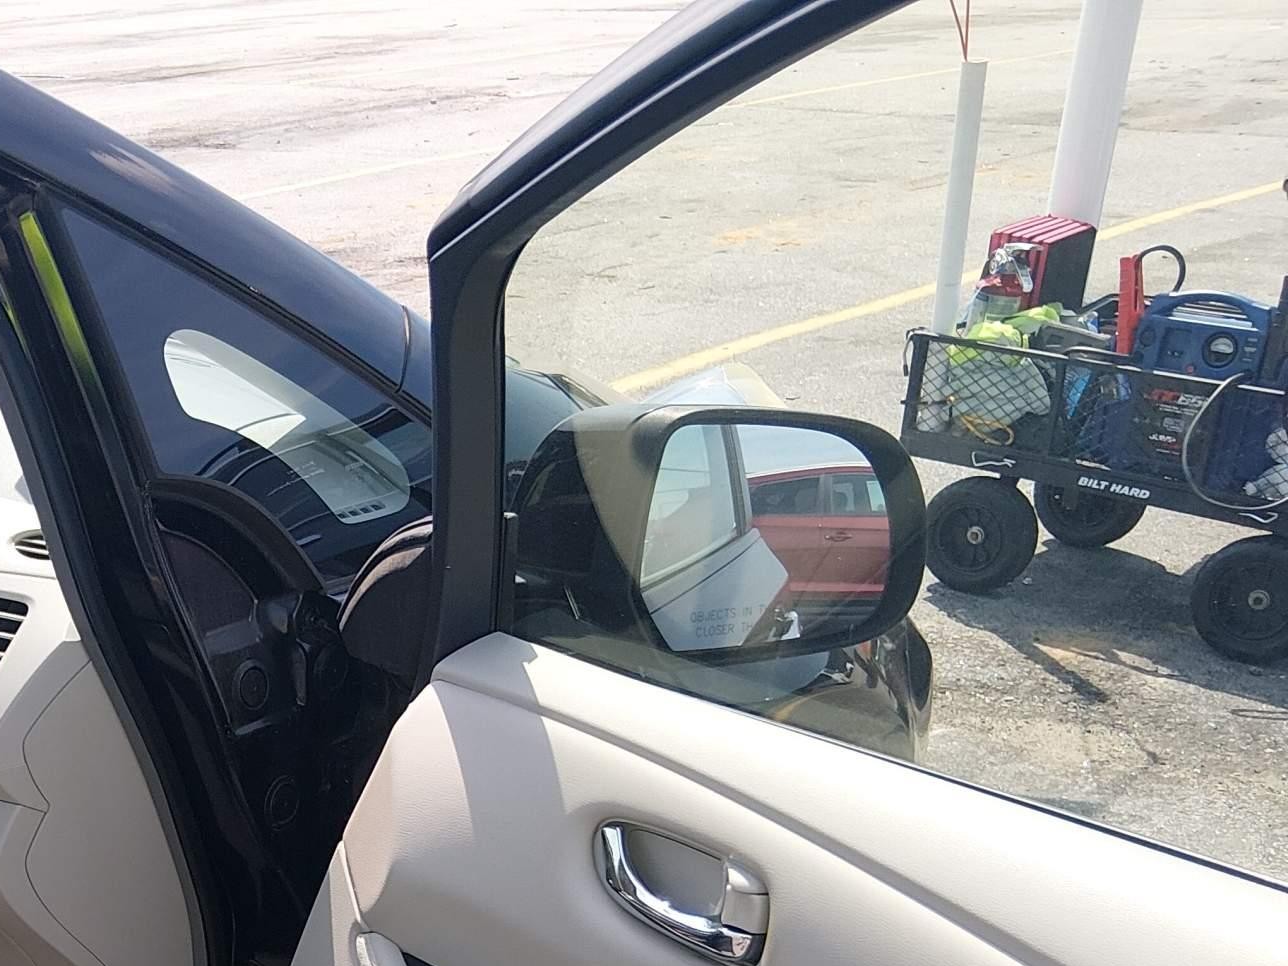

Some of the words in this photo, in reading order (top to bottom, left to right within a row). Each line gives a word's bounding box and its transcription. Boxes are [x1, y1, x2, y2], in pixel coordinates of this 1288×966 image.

[1078, 476, 1109, 491] BILT
[1109, 483, 1151, 499] HARD
[689, 607, 737, 624] OBJECTS
[741, 606, 753, 618] IN
[695, 623, 736, 640] CLOSER
